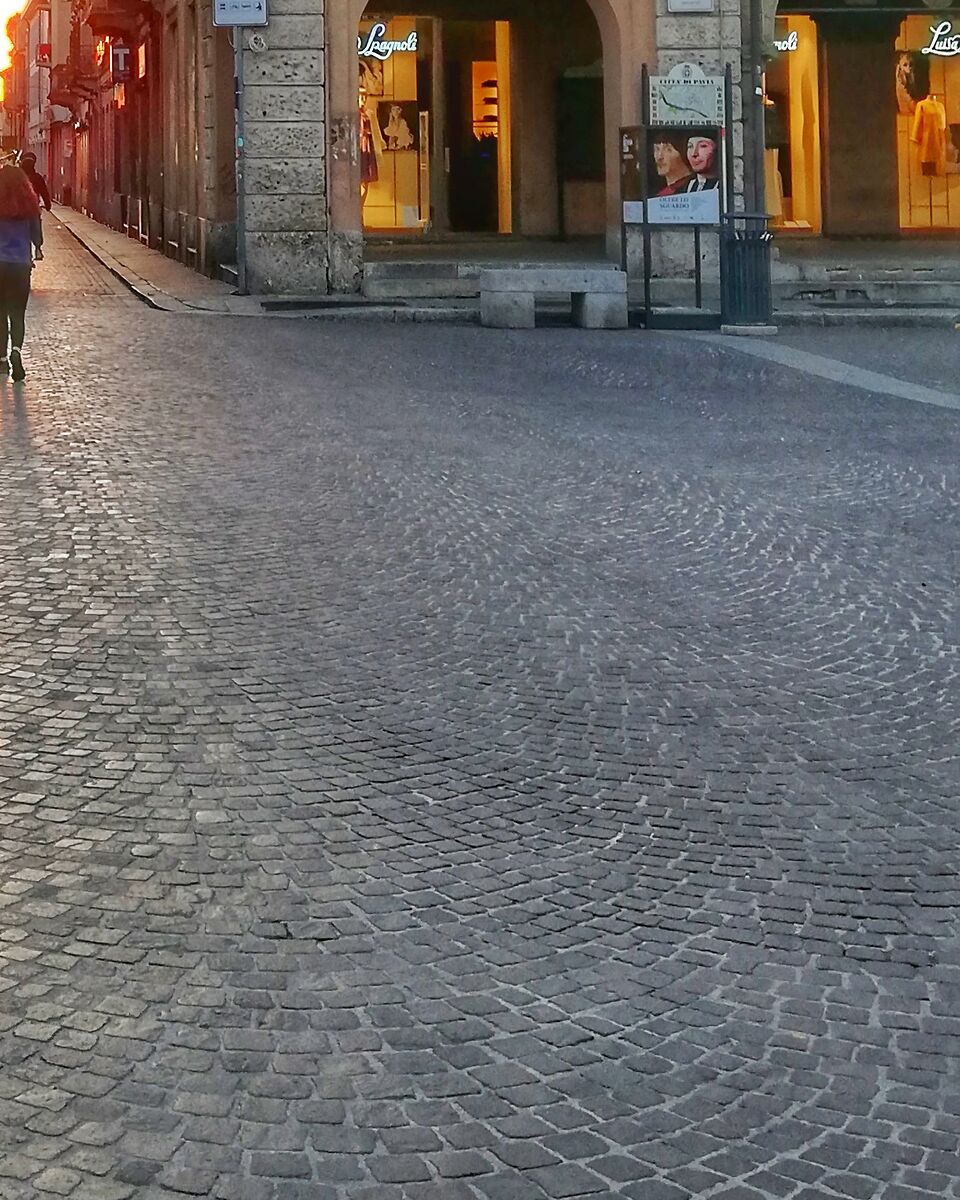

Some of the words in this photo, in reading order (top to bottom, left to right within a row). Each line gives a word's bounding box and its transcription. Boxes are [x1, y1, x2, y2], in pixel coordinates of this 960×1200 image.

[358, 22, 418, 60] Spagnoli
[921, 21, 960, 56] Luisa
[113, 48, 130, 71] T
